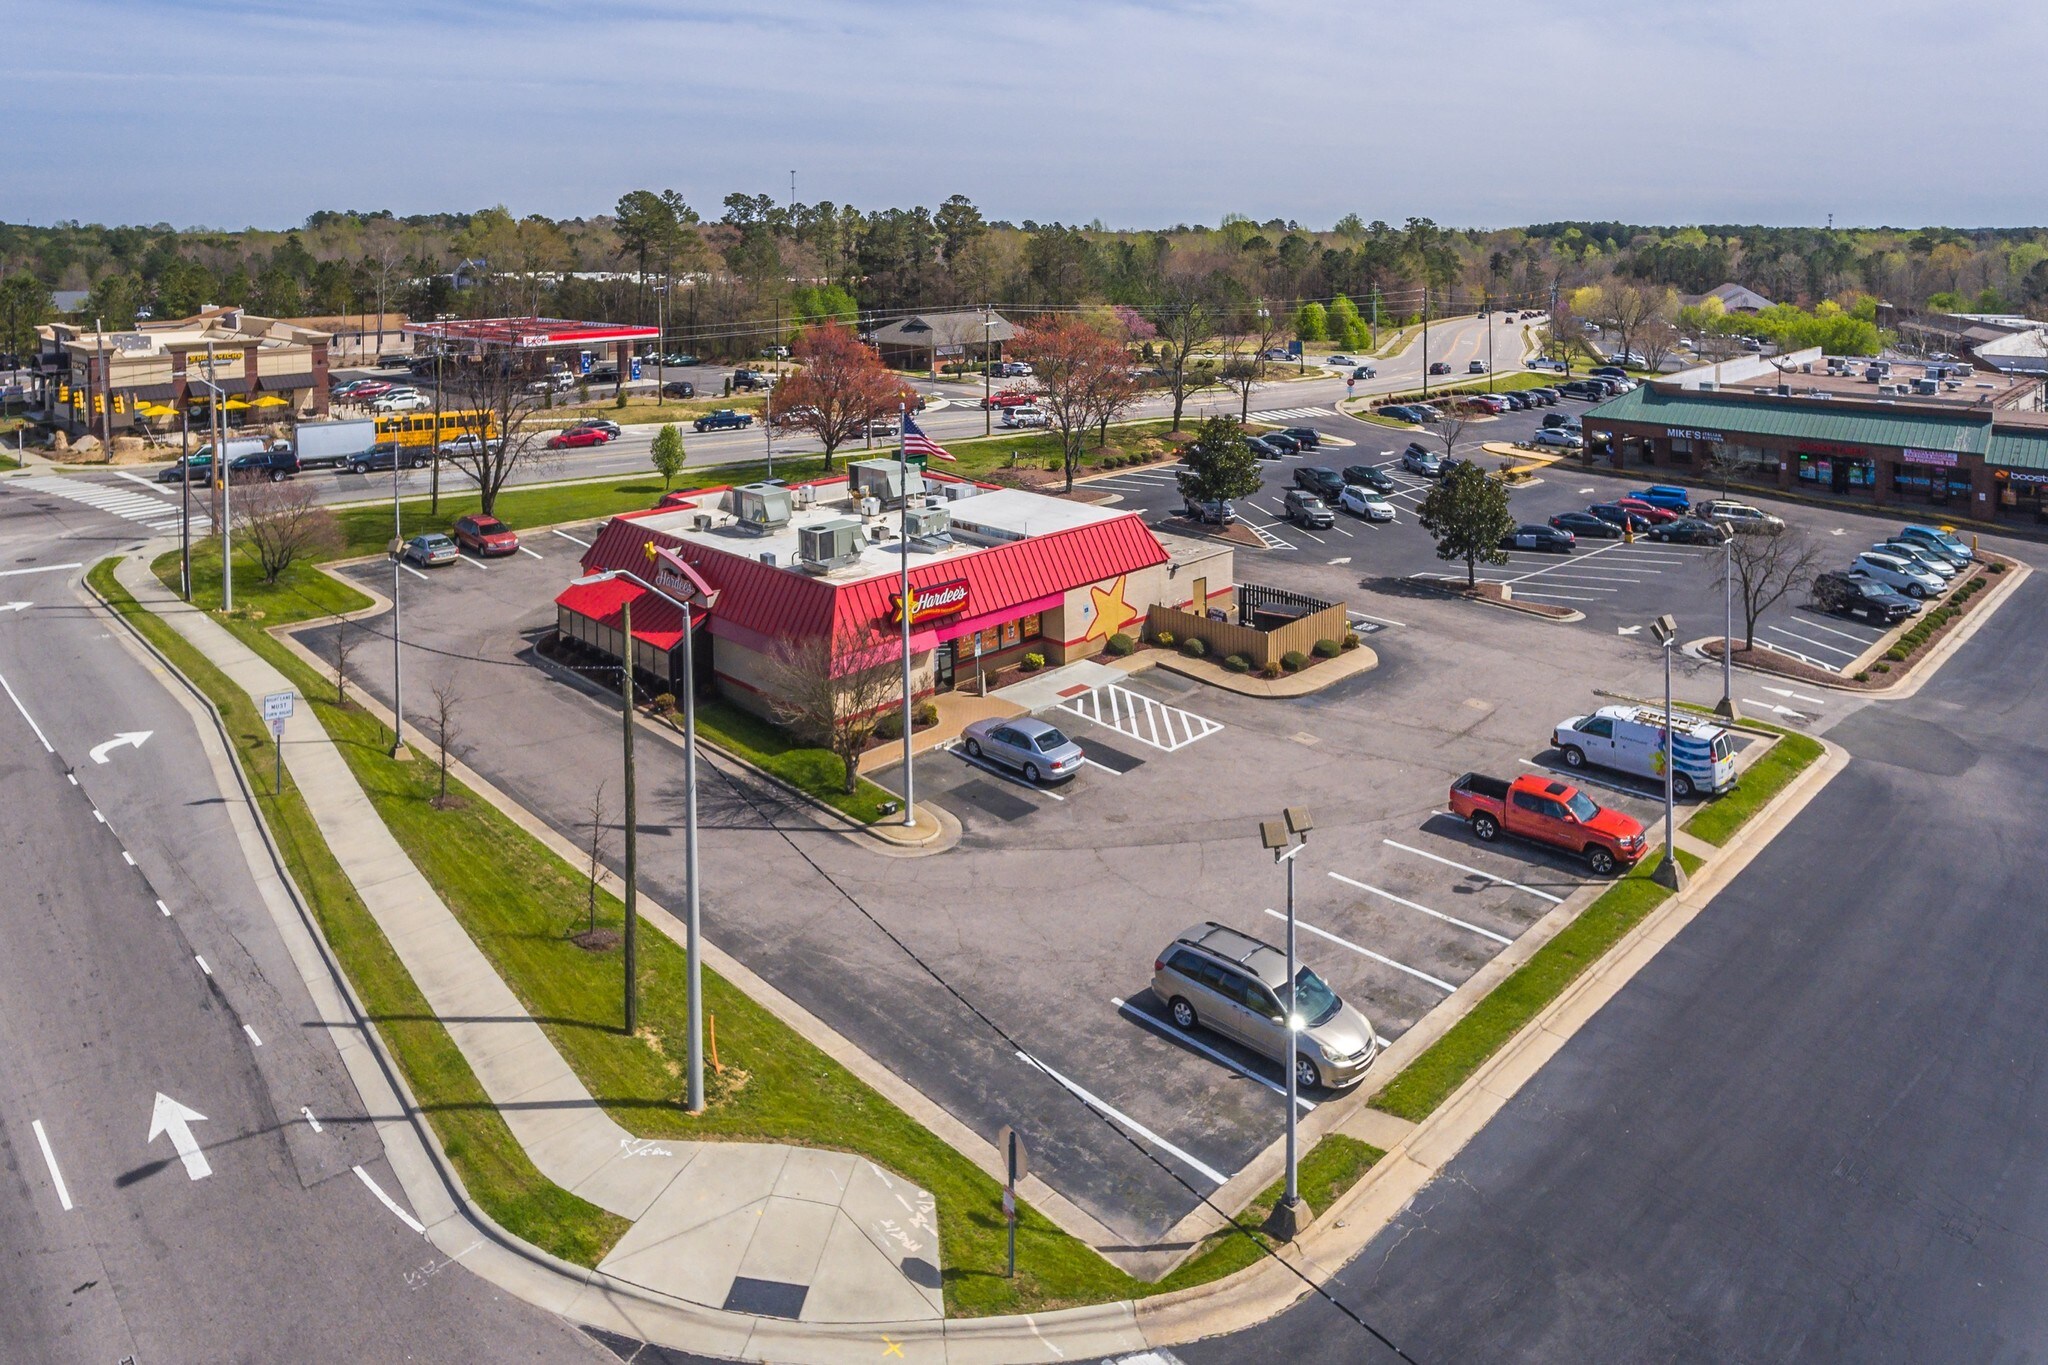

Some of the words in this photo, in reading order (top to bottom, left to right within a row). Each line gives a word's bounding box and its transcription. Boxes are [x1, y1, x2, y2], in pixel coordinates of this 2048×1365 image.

[1667, 428, 1702, 440] MIKE'S
[655, 571, 696, 593] Hardee's
[911, 585, 968, 614] Hardee's
[279, 694, 291, 702] LANE
[271, 702, 287, 710] MUST
